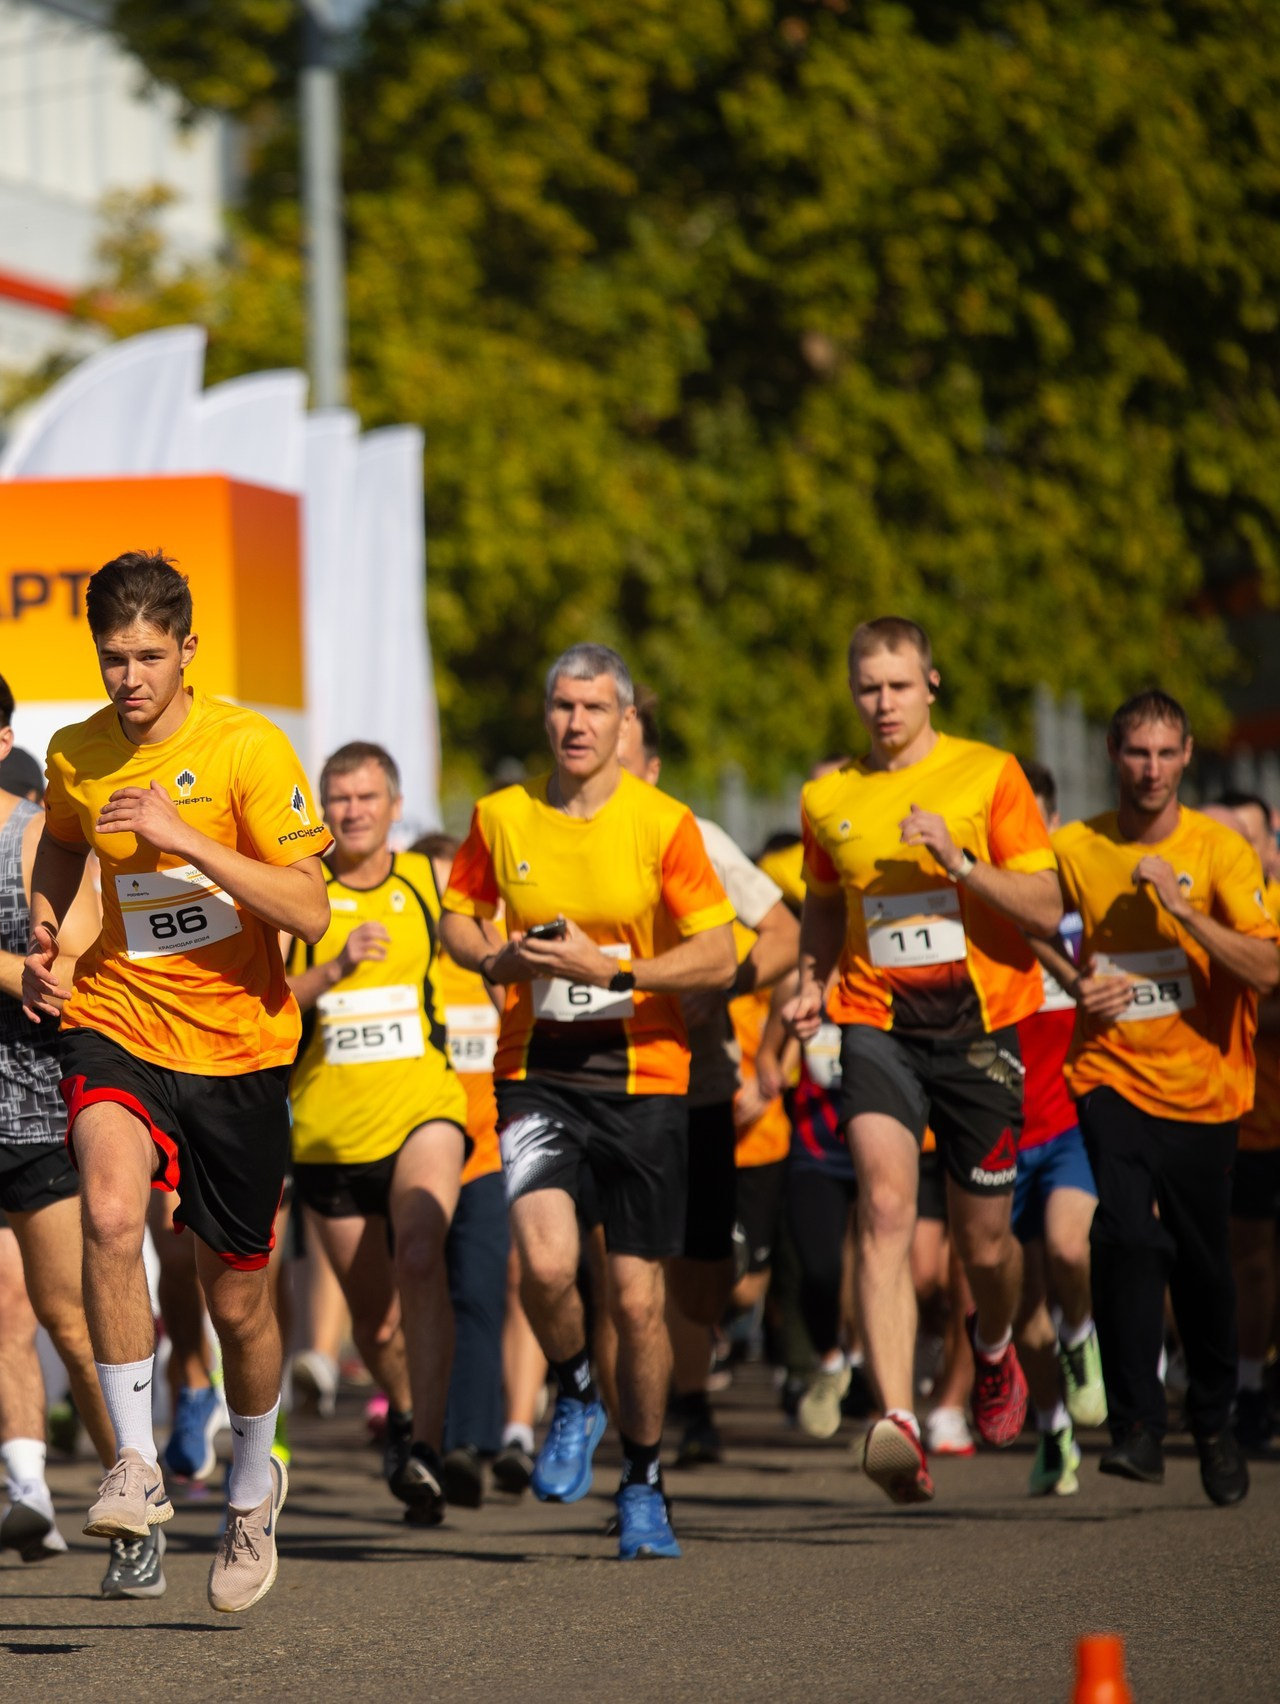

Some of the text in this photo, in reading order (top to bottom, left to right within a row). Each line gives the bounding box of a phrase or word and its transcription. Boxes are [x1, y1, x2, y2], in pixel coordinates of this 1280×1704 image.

[173, 796, 213, 806] СНЕФТЬ
[277, 824, 325, 846] РОСНЕФ
[149, 905, 208, 939] 86
[193, 935, 210, 944] 2024
[889, 927, 932, 952] 11
[336, 1022, 404, 1050] 251
[971, 1165, 1018, 1186] Reebo
